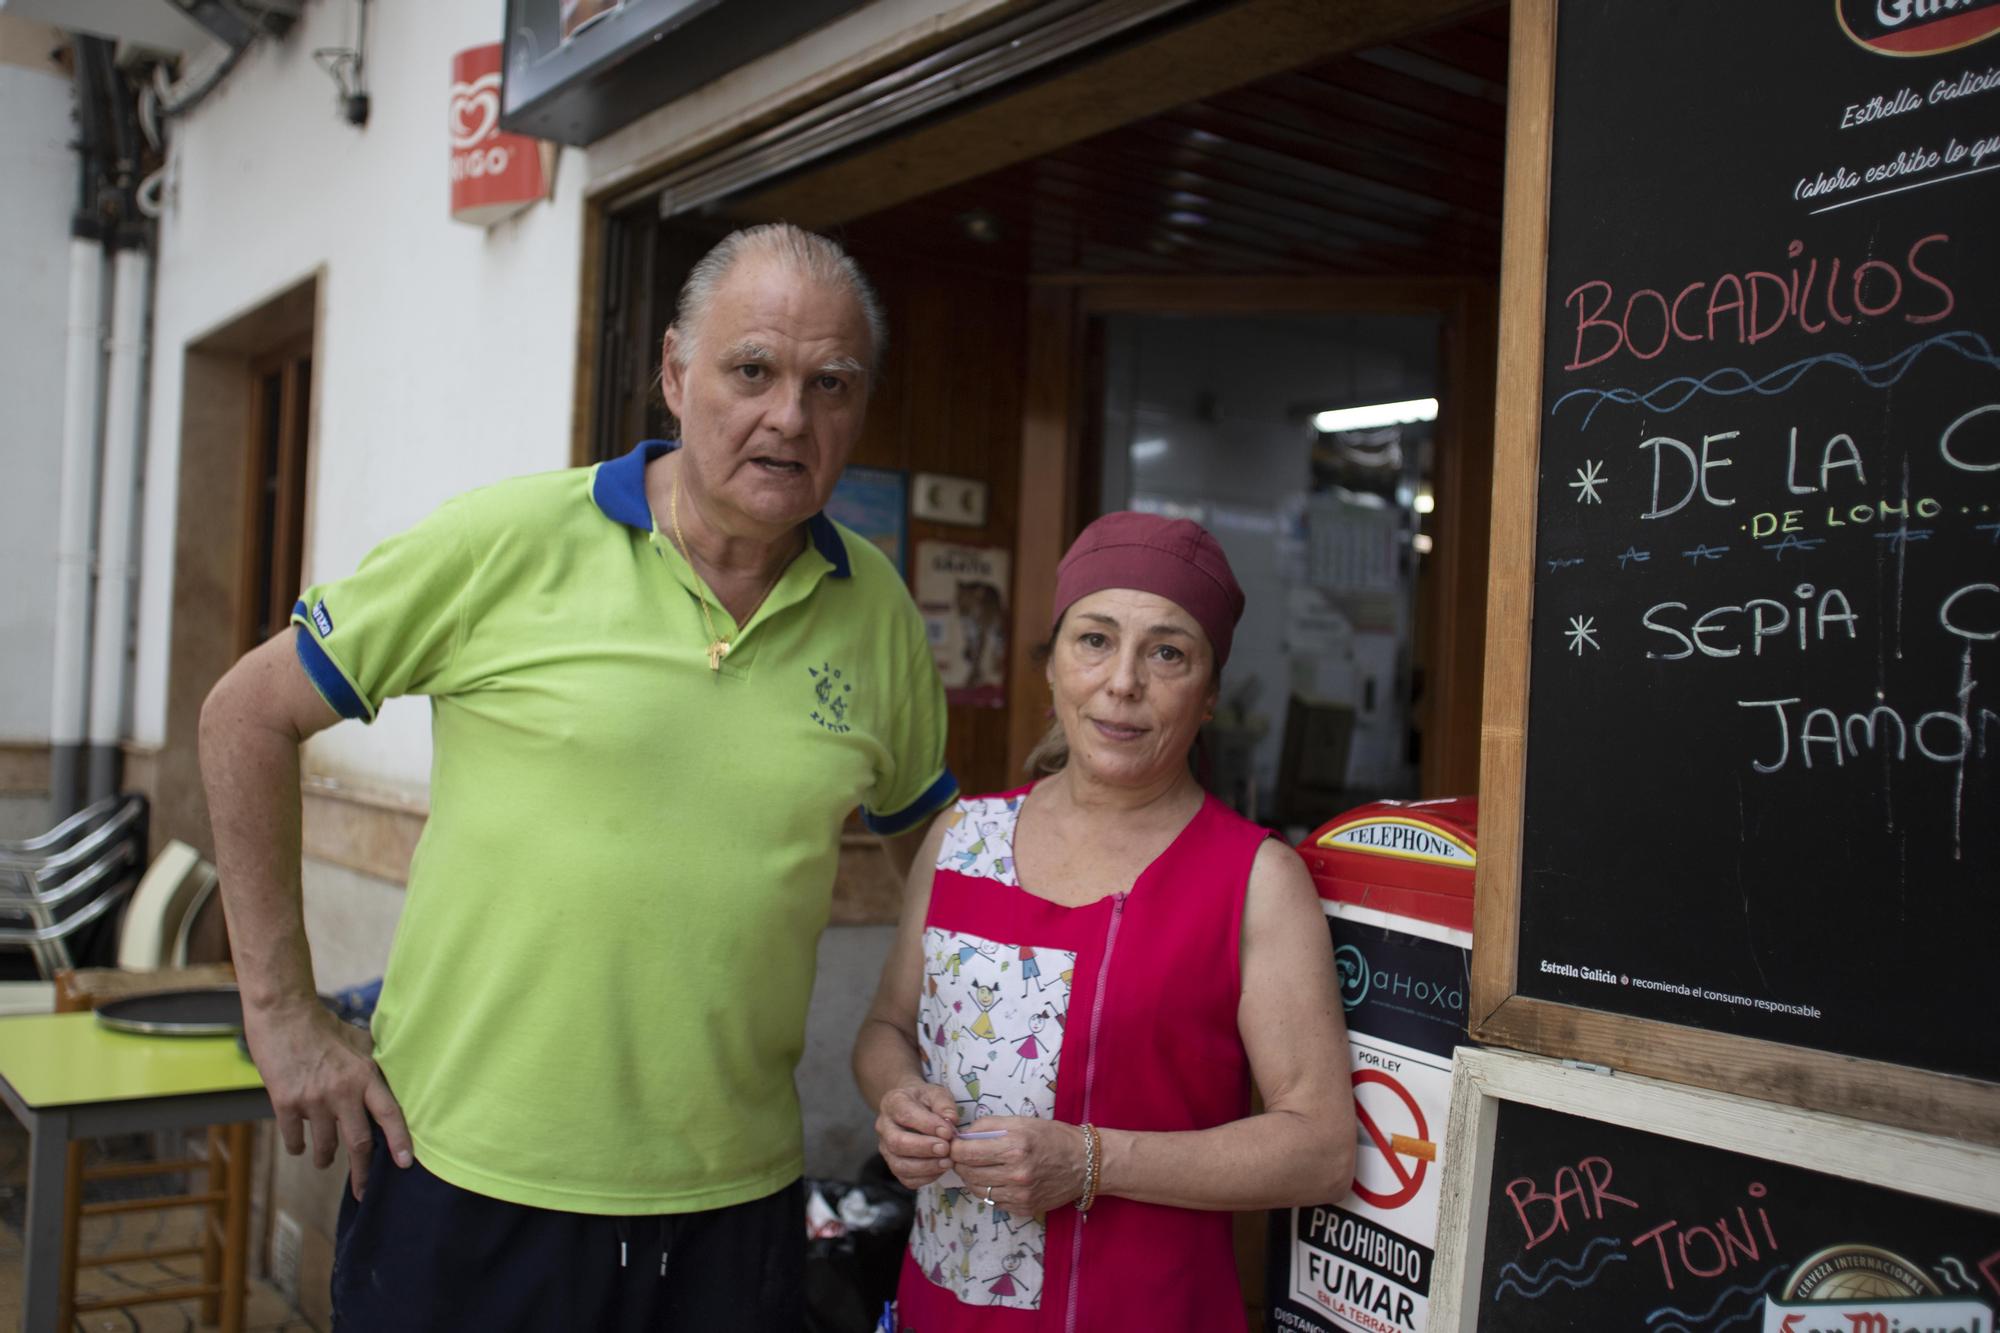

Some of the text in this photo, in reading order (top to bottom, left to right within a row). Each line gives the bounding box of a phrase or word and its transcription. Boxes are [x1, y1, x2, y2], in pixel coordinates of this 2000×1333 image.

[1840, 87, 1923, 129] Estrella
[1865, 146, 1942, 183] escribe
[1944, 138, 1969, 164] lo
[1639, 430, 1741, 520] DE
[1788, 427, 1867, 494] LA
[1347, 825, 1455, 858] TELEPHONE
[1540, 960, 1822, 1019] Estrella Galicia recomienda el consumo responsable
[1358, 1051, 1402, 1073] POR LEY
[1505, 1156, 1639, 1251] BAR
[1309, 1208, 1421, 1284] PROHIBIDO
[1307, 1251, 1416, 1331] FUMAR
[1797, 1254, 1925, 1299] CERVEZA INTERNACIONAL
[1317, 1290, 1334, 1304] EN
[1333, 1300, 1347, 1316] LA
